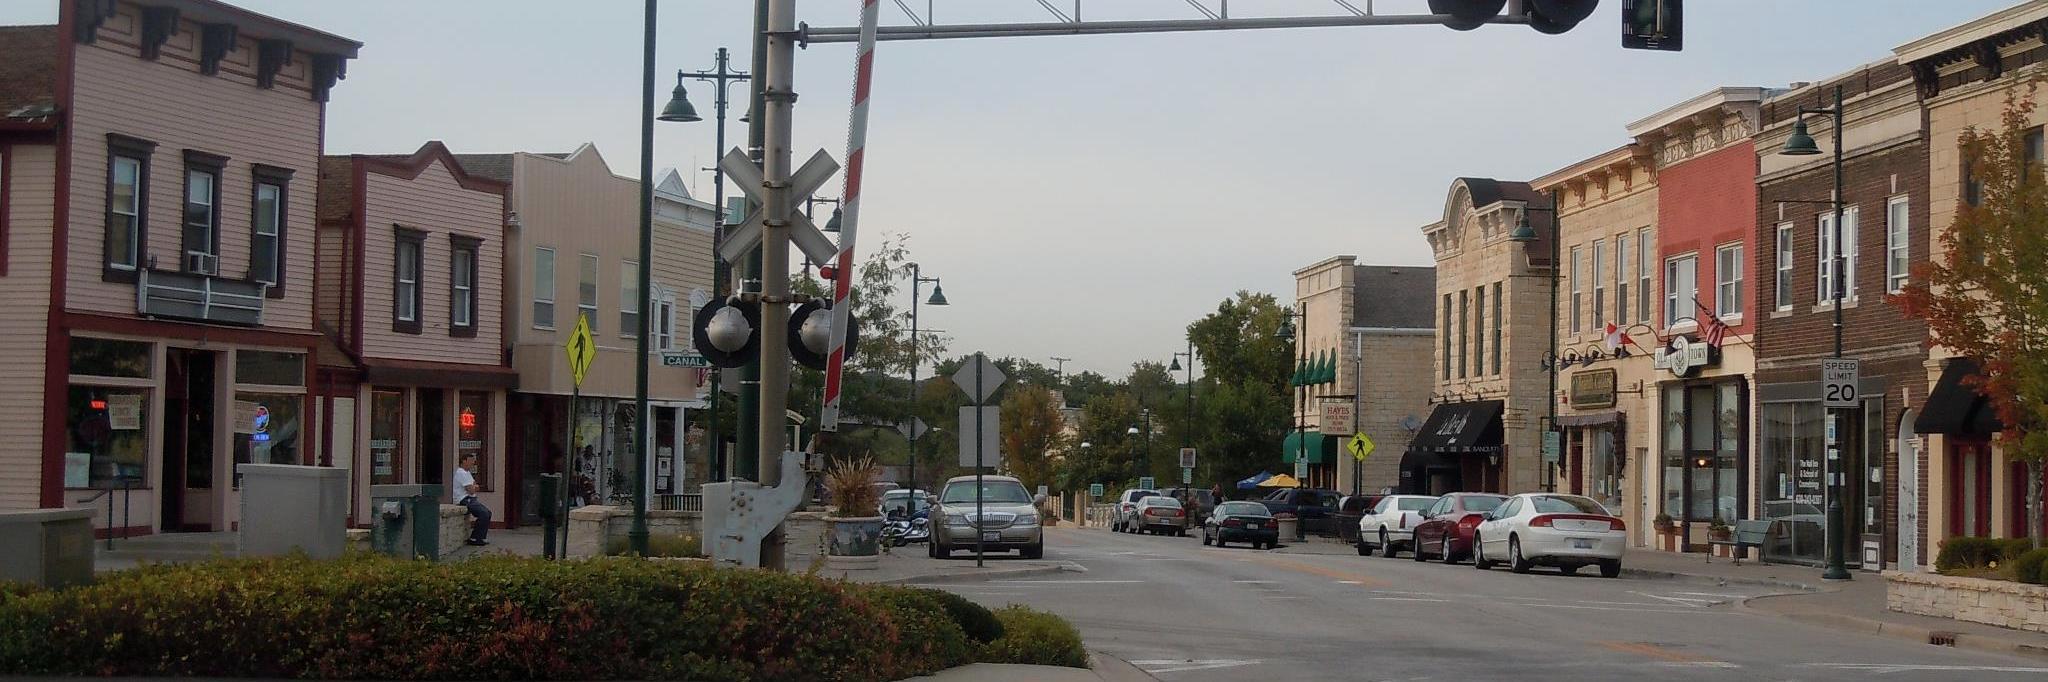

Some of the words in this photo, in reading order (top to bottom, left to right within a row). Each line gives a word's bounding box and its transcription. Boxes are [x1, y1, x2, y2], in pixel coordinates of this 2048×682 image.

[668, 357, 702, 366] CANAL
[1825, 362, 1856, 370] SPEED
[1828, 372, 1854, 380] LIMIT
[1826, 383, 1855, 401] 20
[1327, 406, 1350, 415] HAYES
